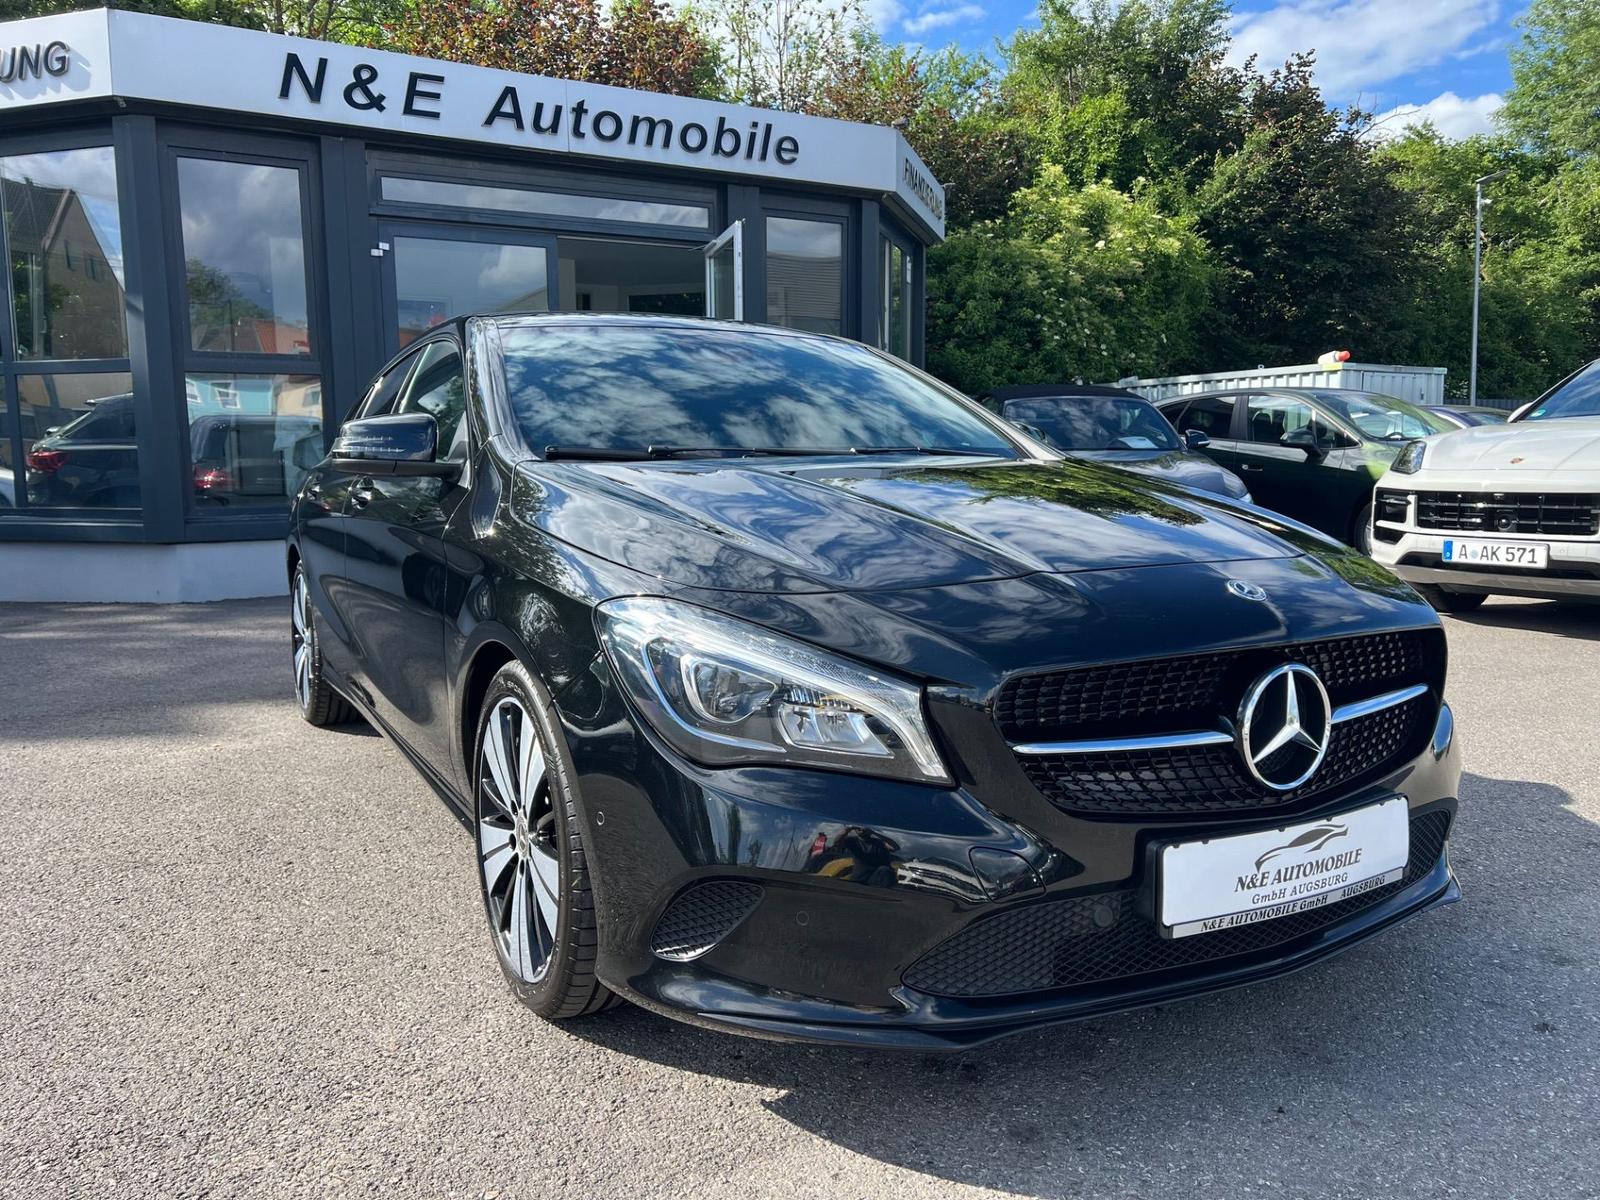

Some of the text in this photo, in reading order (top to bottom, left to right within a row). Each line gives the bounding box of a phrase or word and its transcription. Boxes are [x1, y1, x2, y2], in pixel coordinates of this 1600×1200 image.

[481, 85, 800, 165] Automobile
[1458, 544, 1538, 564] A AK 571
[1234, 848, 1363, 892] N&E AUTOMOBILE
[1251, 872, 1348, 905] GmbH AUGSBURG
[1200, 875, 1386, 932] N&E AUTOMOBILE GmbH AUGSBURG
